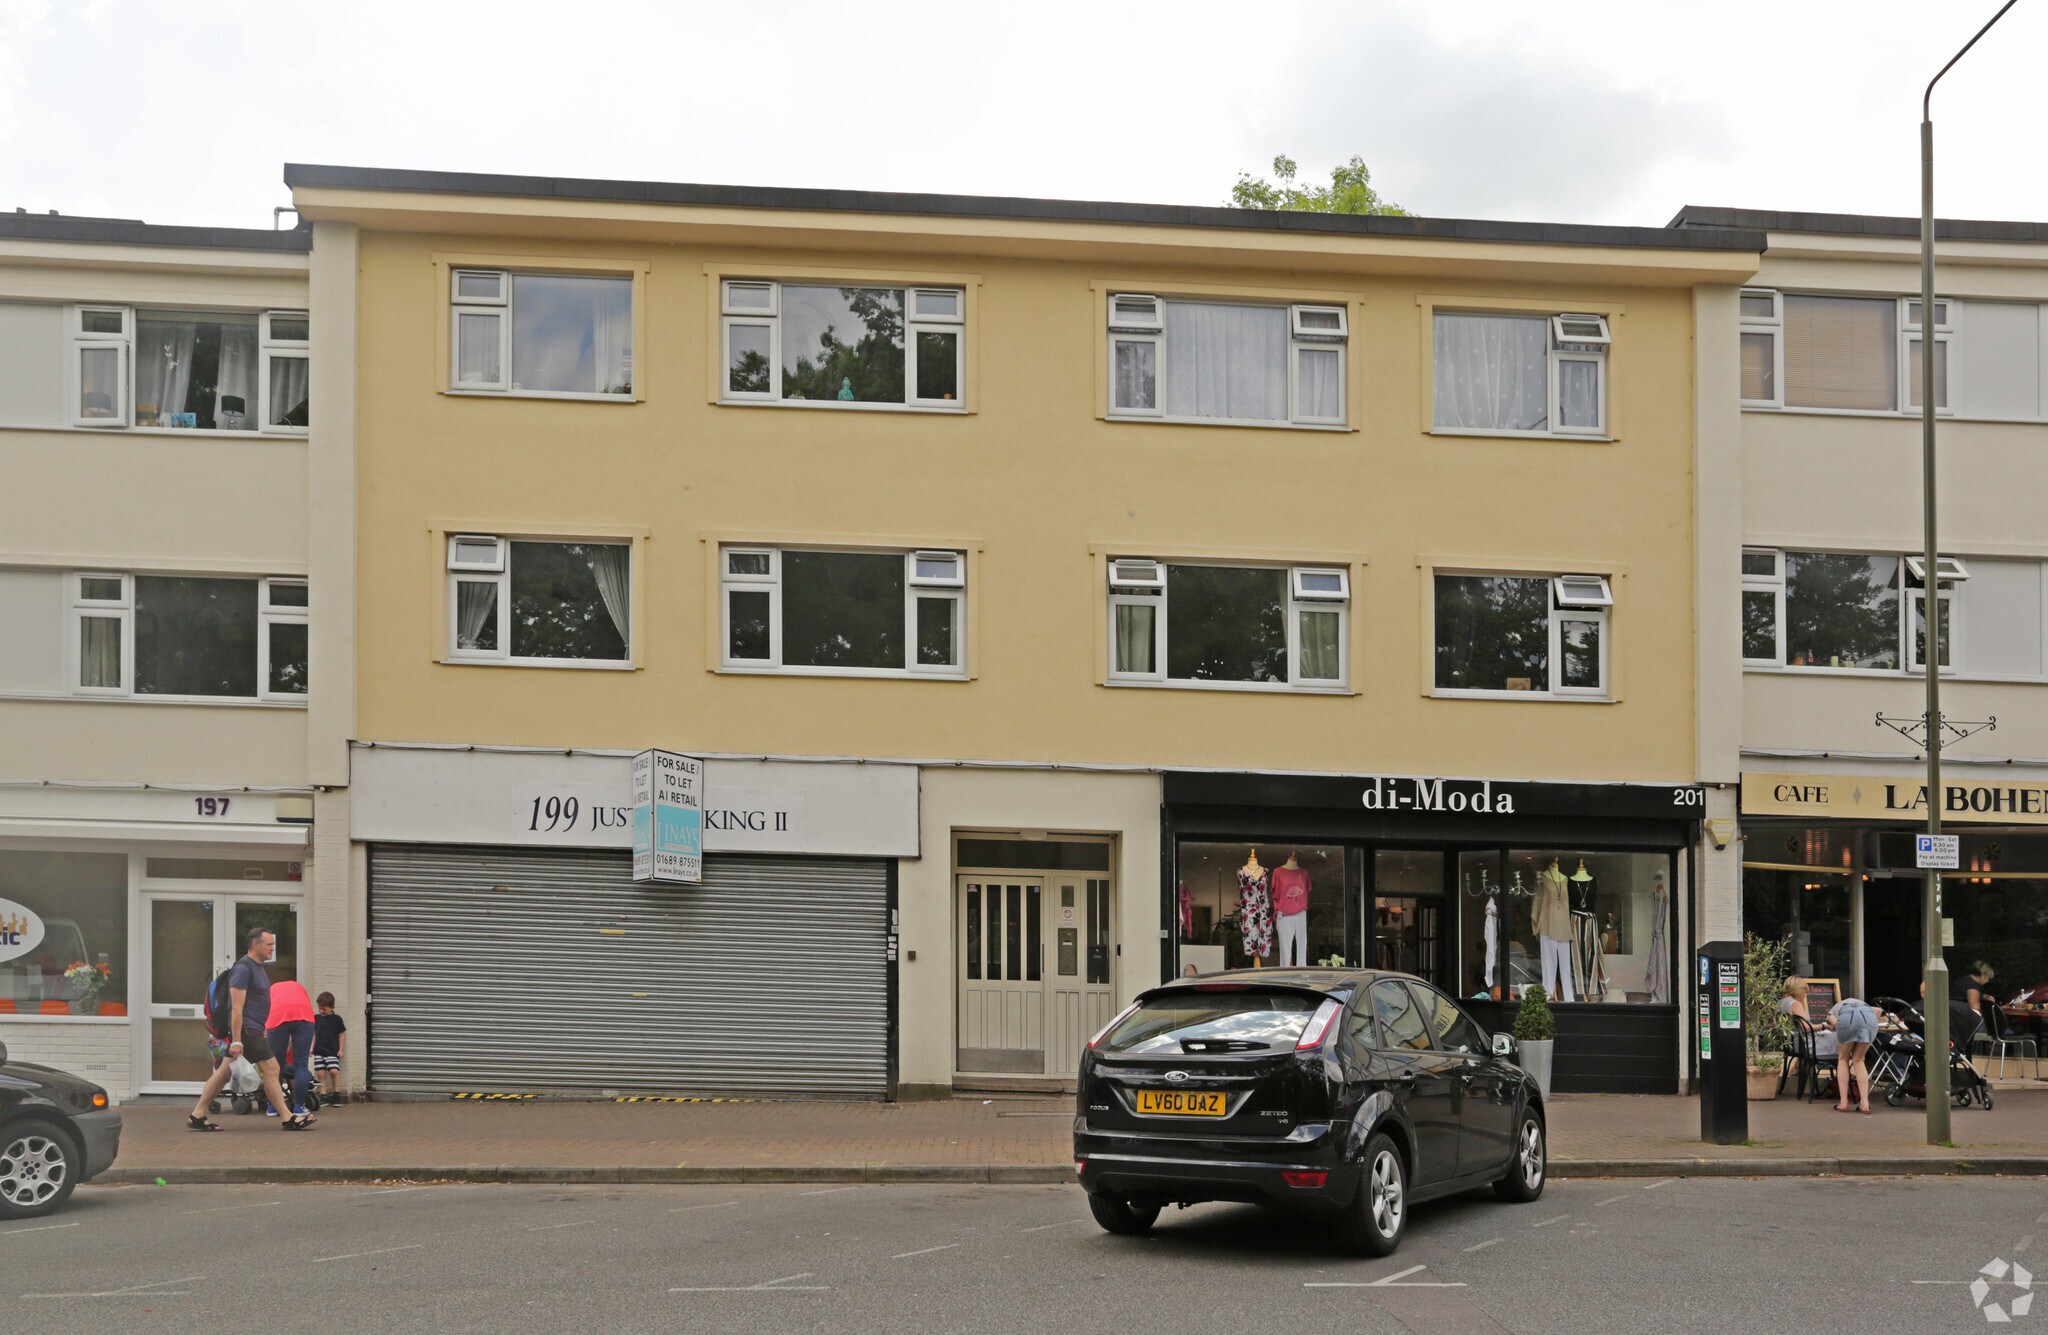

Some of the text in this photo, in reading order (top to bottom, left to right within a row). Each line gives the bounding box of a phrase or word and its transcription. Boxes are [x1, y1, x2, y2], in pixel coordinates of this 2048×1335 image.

[657, 756, 674, 770] FOR
[675, 760, 696, 775] SALE
[664, 773, 693, 790] TO LET
[670, 791, 698, 807] RETAIL
[1362, 777, 1515, 814] di-Moda
[1673, 788, 1706, 806] 201
[1773, 784, 1829, 803] CAFE
[195, 797, 230, 816] 197
[528, 796, 580, 833] 199
[704, 810, 766, 832] KING
[774, 811, 788, 832] II
[657, 822, 700, 855] LINAYS
[656, 853, 677, 866] 01689
[1143, 1092, 1220, 1112] LV60 OAZ
